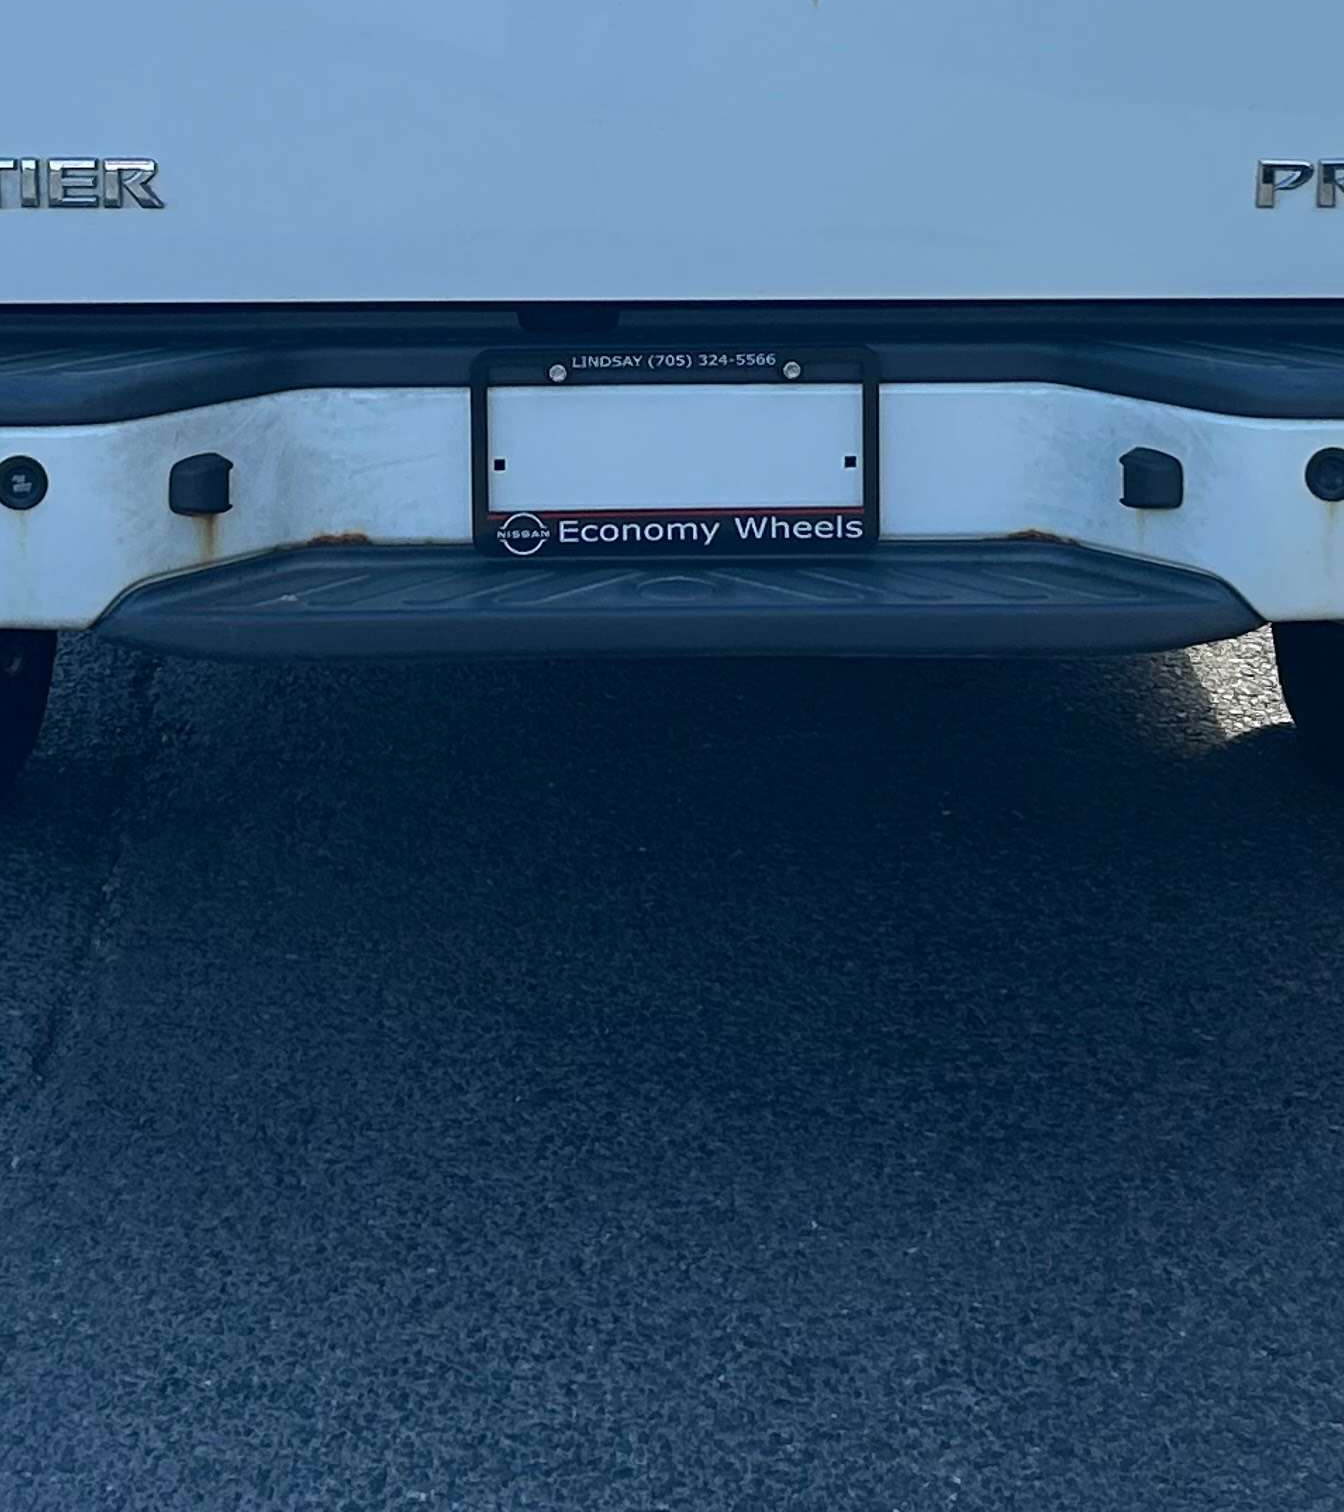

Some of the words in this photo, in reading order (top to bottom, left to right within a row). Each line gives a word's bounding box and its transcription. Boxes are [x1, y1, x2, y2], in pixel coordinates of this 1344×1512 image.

[572, 355, 642, 369] LINDSAY
[647, 354, 693, 368] (705)
[699, 353, 776, 367] 324-5566
[497, 528, 550, 538] NISSAN
[559, 520, 719, 546] Economy
[735, 514, 863, 541] Wheels
